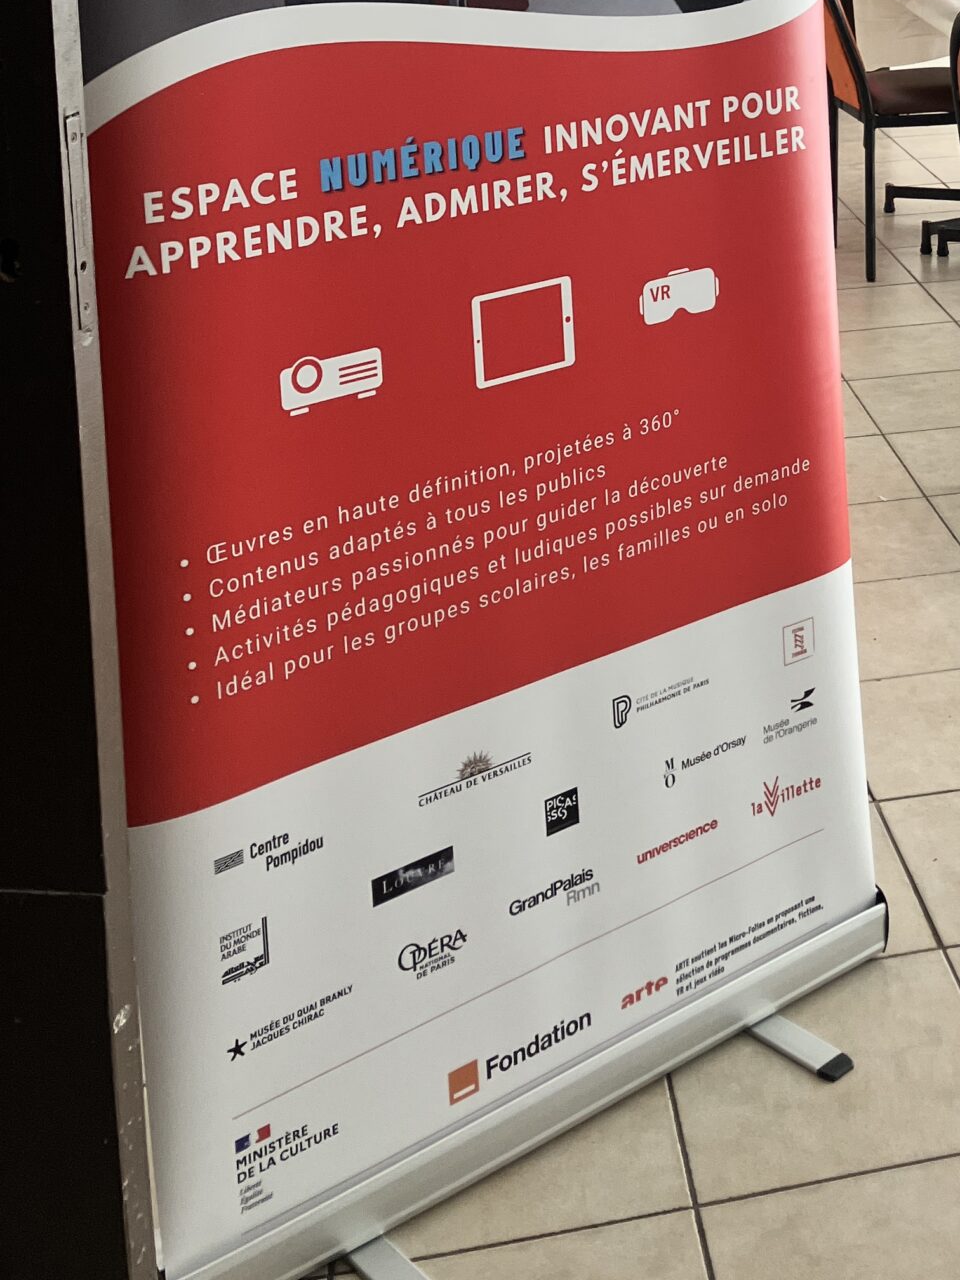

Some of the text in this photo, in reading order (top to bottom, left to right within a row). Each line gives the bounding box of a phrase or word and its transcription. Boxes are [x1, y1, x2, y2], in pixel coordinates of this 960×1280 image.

[143, 85, 801, 224] ESPACE NUMÉRIQUE INNOVANT POUR
[124, 126, 806, 279] APPRENDRE, ADMIRER, S'ÉMERVEILLER
[650, 285, 671, 302] VR
[206, 408, 681, 565] Œuvres en haute définition, projetées à 360°
[209, 463, 607, 598] Contenus adaptés à tous les publics
[211, 455, 728, 633] Médiateurs passionnés pour guider la découverte
[214, 456, 811, 667] Activités pédagogiques et ludiques possibles sur demande
[216, 493, 788, 700] Idéal pour les groupes scolaires, les familles ou en solo
[636, 679, 710, 713] PHILHARMONIE DE PARIS
[763, 718, 790, 735] Musée
[763, 734, 774, 745] de
[681, 735, 747, 770] Musée d'Orsay
[418, 756, 532, 807] CHÂTEAU DE VERSAILLES
[250, 833, 289, 859] Centre
[266, 835, 324, 872] Pompidou
[636, 819, 718, 865] universcience
[566, 882, 600, 906] Rmn
[219, 923, 252, 944] INSTITUT
[220, 928, 262, 953] DU MONDE
[220, 944, 247, 962] ARABE
[675, 960, 690, 973] ARTE
[691, 945, 717, 965] soutient
[718, 940, 728, 951] les
[767, 916, 773, 925] en
[775, 899, 804, 922] proposant
[805, 895, 815, 906] une
[416, 956, 455, 980] DE PARIS
[706, 959, 713, 970] de
[714, 941, 751, 966] programmes
[250, 985, 353, 1042] MUSÉE DU QUAI BRANLY
[621, 976, 668, 1010] arte
[250, 1008, 325, 1051] JACQUES CHIRAC
[486, 1011, 592, 1080] Fondation
[236, 1124, 309, 1171] MINISTÈRE
[237, 1122, 340, 1185] DE LA CULTURE
